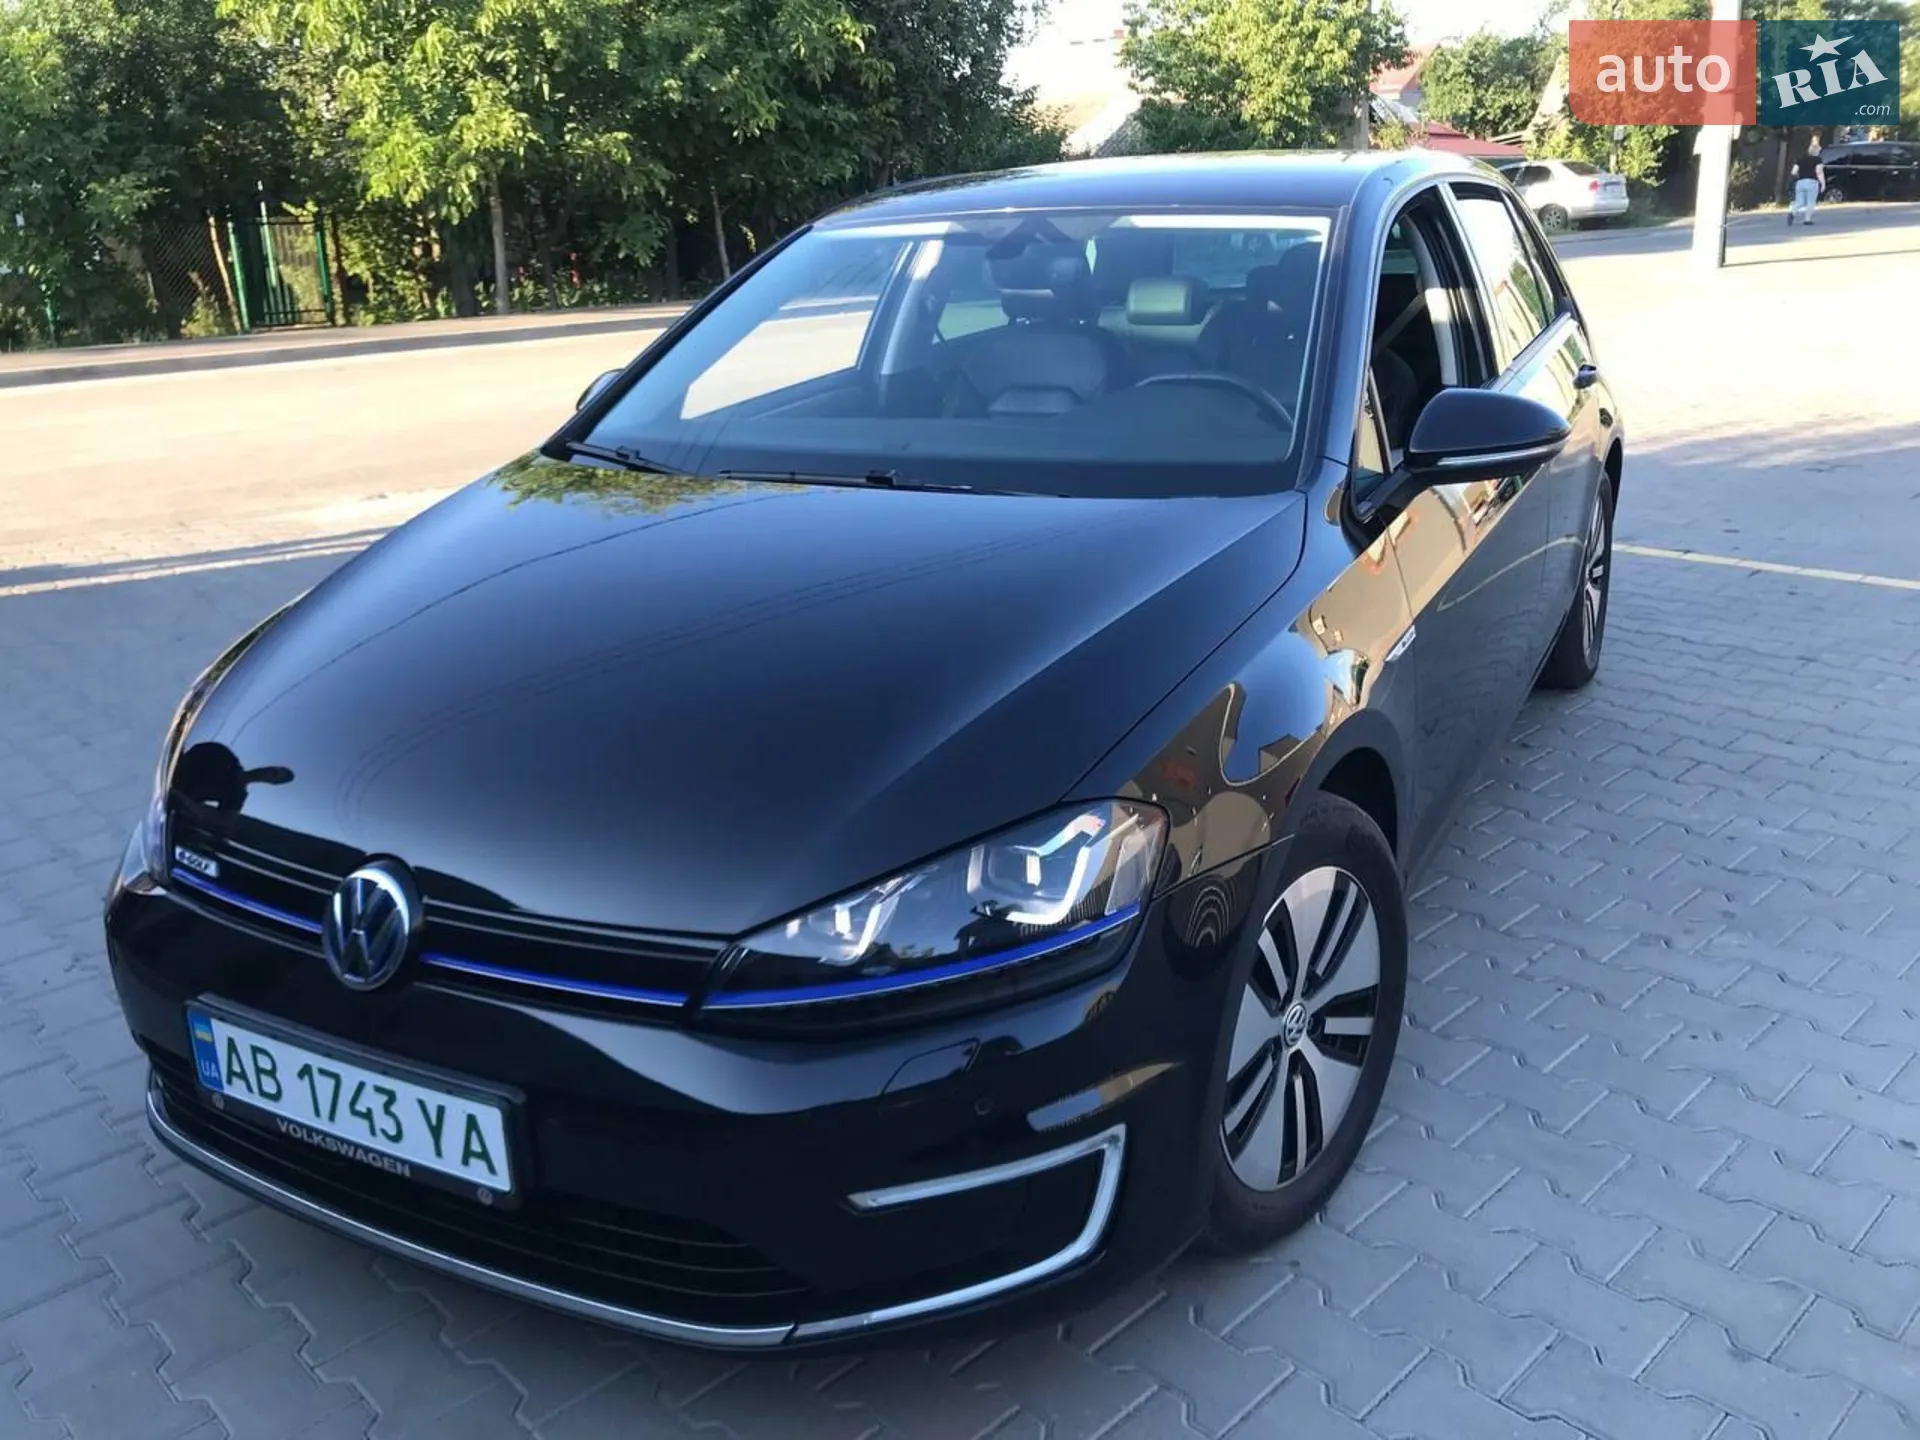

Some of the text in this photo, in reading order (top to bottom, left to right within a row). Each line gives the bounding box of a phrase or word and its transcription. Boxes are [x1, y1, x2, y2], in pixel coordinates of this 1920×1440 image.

[200, 1059, 220, 1082] UA
[225, 1036, 498, 1176] AB 1743 YA
[276, 1117, 411, 1179] VOLKSWAGEN
